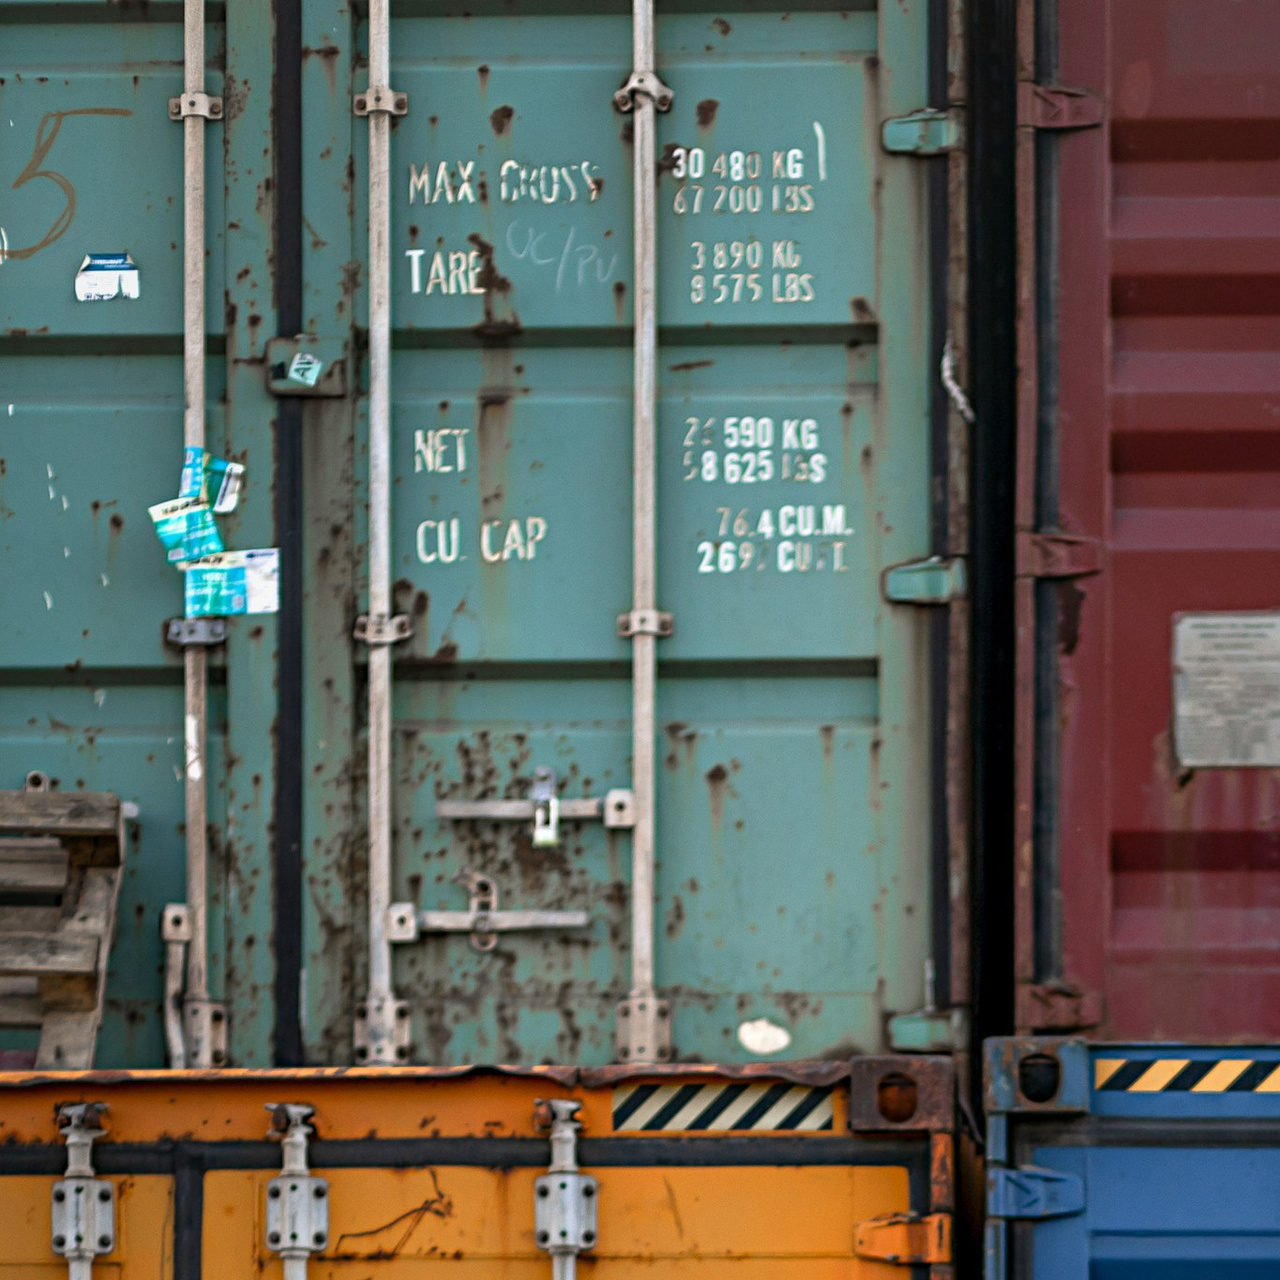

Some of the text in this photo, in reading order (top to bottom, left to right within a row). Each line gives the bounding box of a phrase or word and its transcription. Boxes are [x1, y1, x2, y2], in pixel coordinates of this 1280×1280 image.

[672, 148, 803, 181] 30 480 KG
[0, 107, 133, 259] 5
[409, 160, 476, 204] MAX
[673, 184, 815, 214] 67 200 LBS
[405, 249, 487, 295] TARE
[691, 240, 802, 270] 3 890 KG
[713, 274, 763, 303] 575
[772, 273, 815, 303] LBS
[724, 416, 774, 448] 590
[782, 419, 818, 450] KG
[414, 428, 470, 473] NET
[724, 450, 774, 484] 625
[480, 517, 548, 562] CAP
